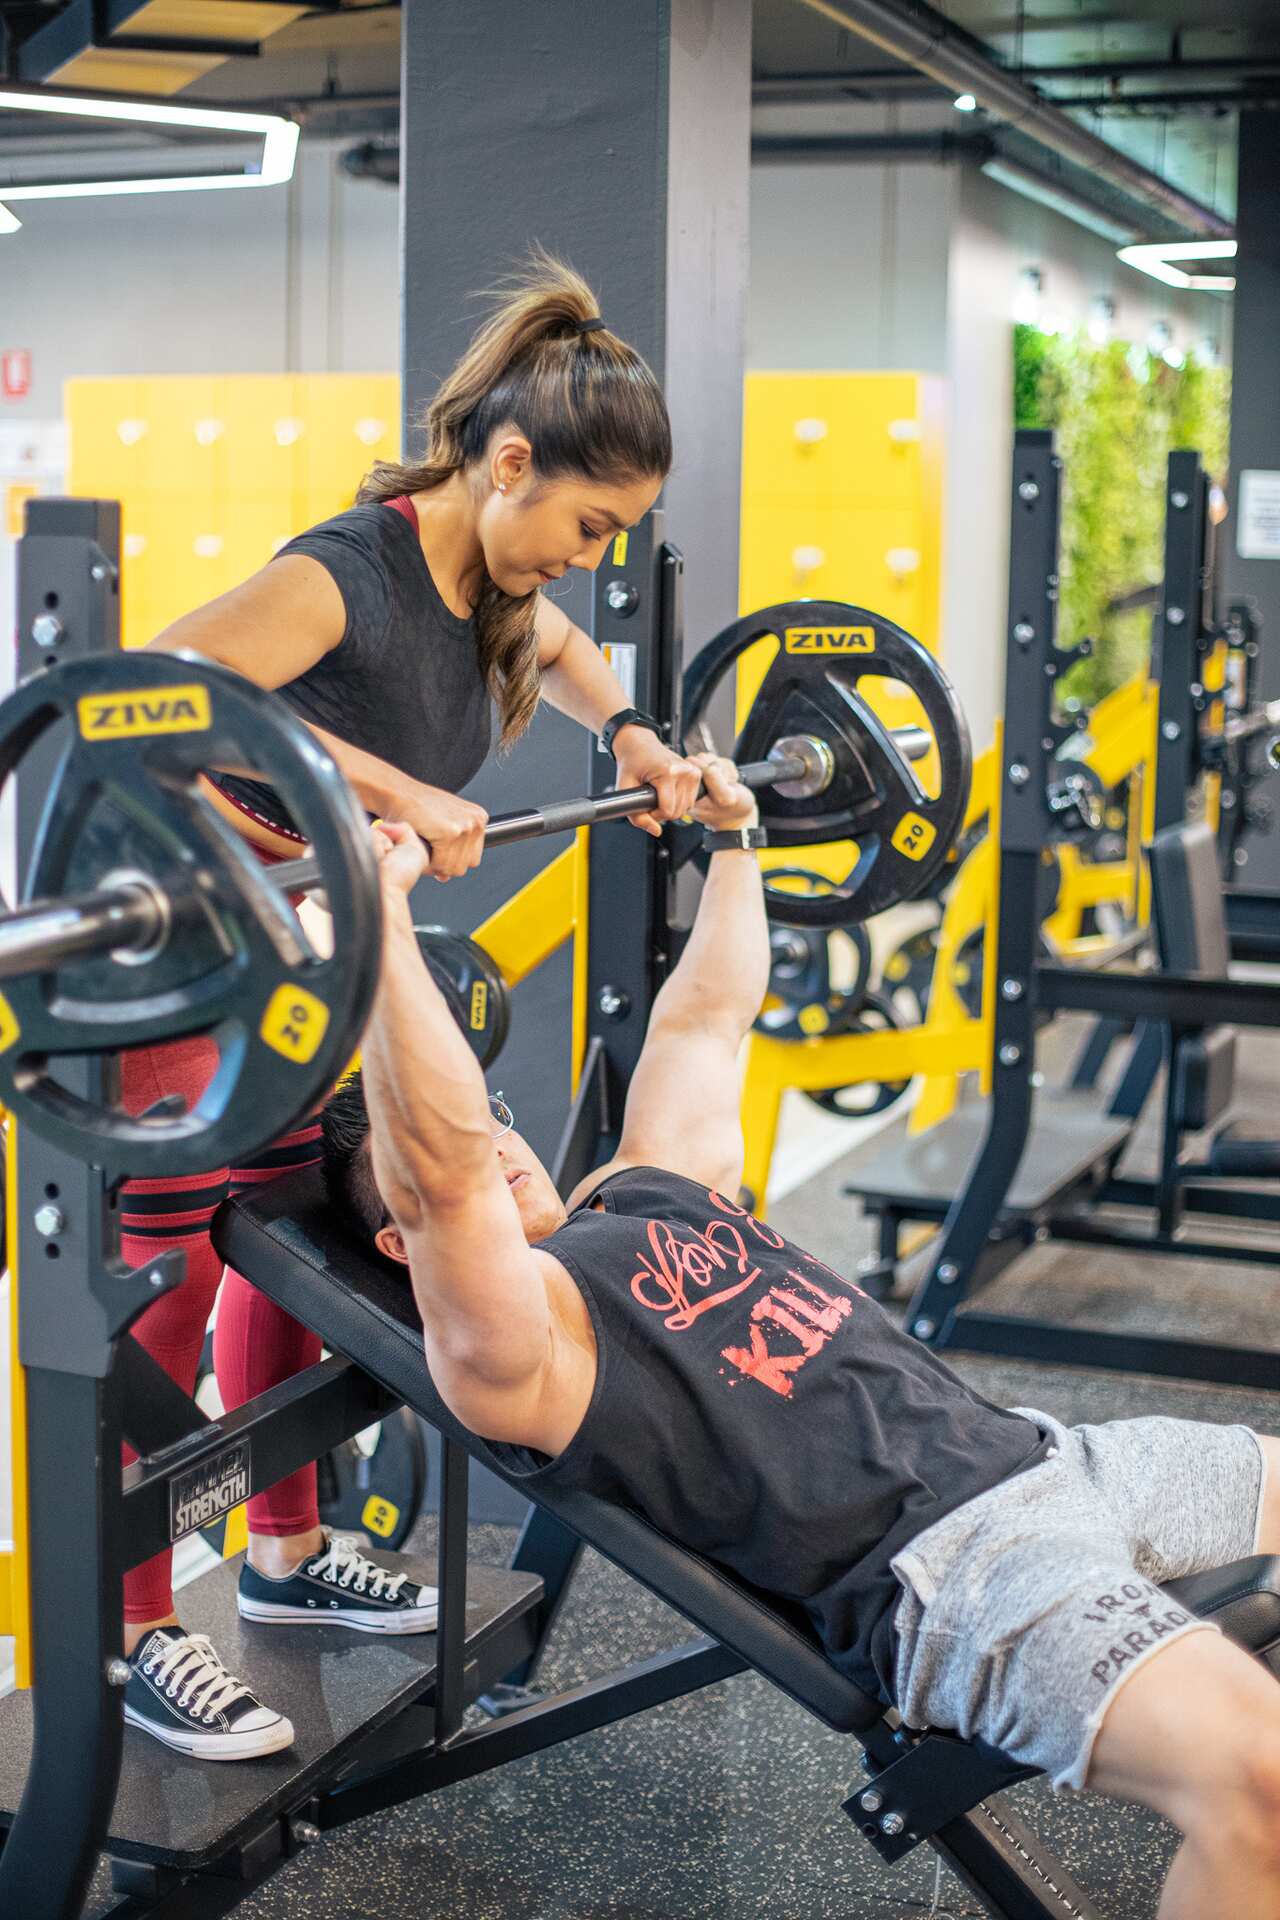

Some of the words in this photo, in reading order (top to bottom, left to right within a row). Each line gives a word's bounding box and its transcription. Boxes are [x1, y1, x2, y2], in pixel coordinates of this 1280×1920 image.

[791, 633, 868, 649] ZIVA
[90, 698, 200, 728] ZIVA
[902, 824, 924, 852] 20
[279, 1004, 309, 1047] 20
[719, 1252, 869, 1401] KILL
[175, 1470, 247, 1535] STRENGTH
